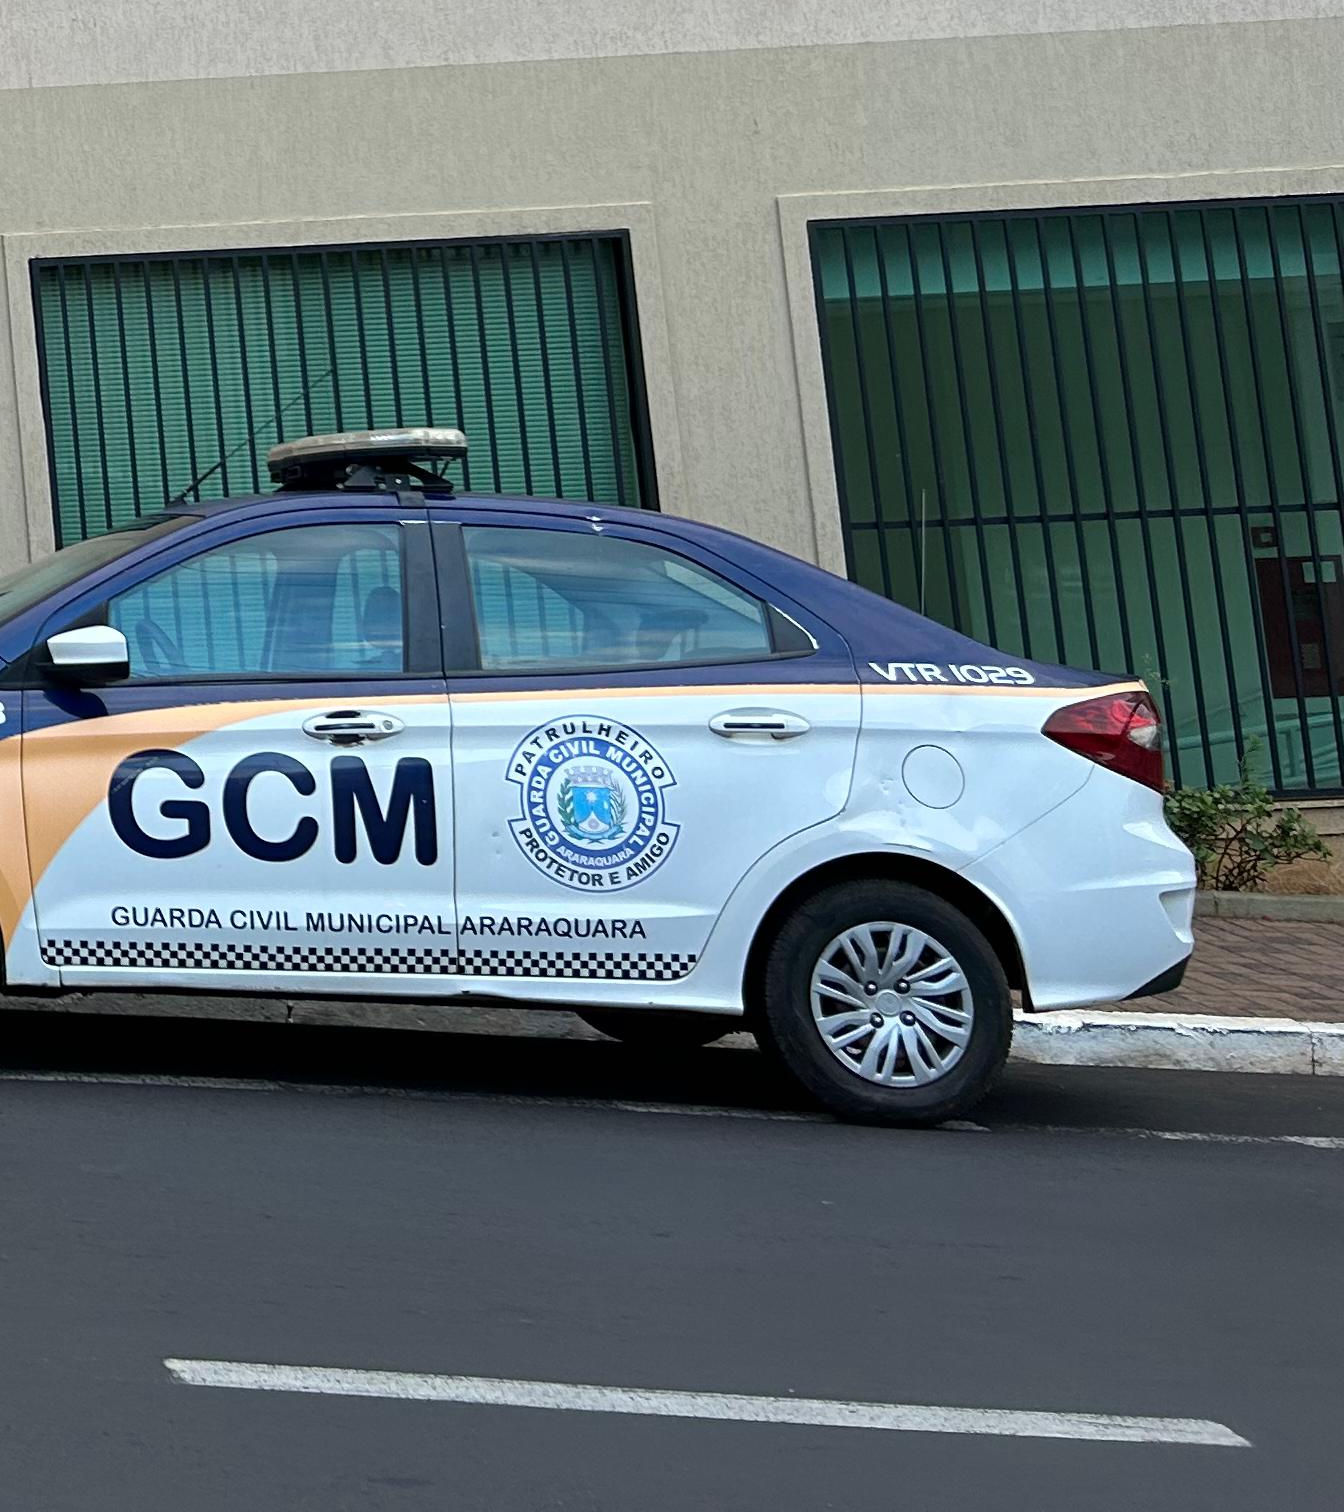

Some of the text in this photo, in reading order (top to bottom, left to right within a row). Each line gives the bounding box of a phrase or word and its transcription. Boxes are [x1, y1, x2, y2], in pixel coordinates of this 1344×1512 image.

[868, 662, 1035, 685] VTR 1029
[514, 721, 665, 779] PATRULHEIRO
[107, 748, 438, 866] GCM
[530, 740, 657, 847] GUARDA CIVIL MUNICIPAL
[519, 828, 670, 887] PROTETOR E AMIGO
[556, 846, 635, 867] ARARAQUARA
[111, 906, 647, 939] GUARDA CIVIL MUNICIPAL ARARAQUARA
